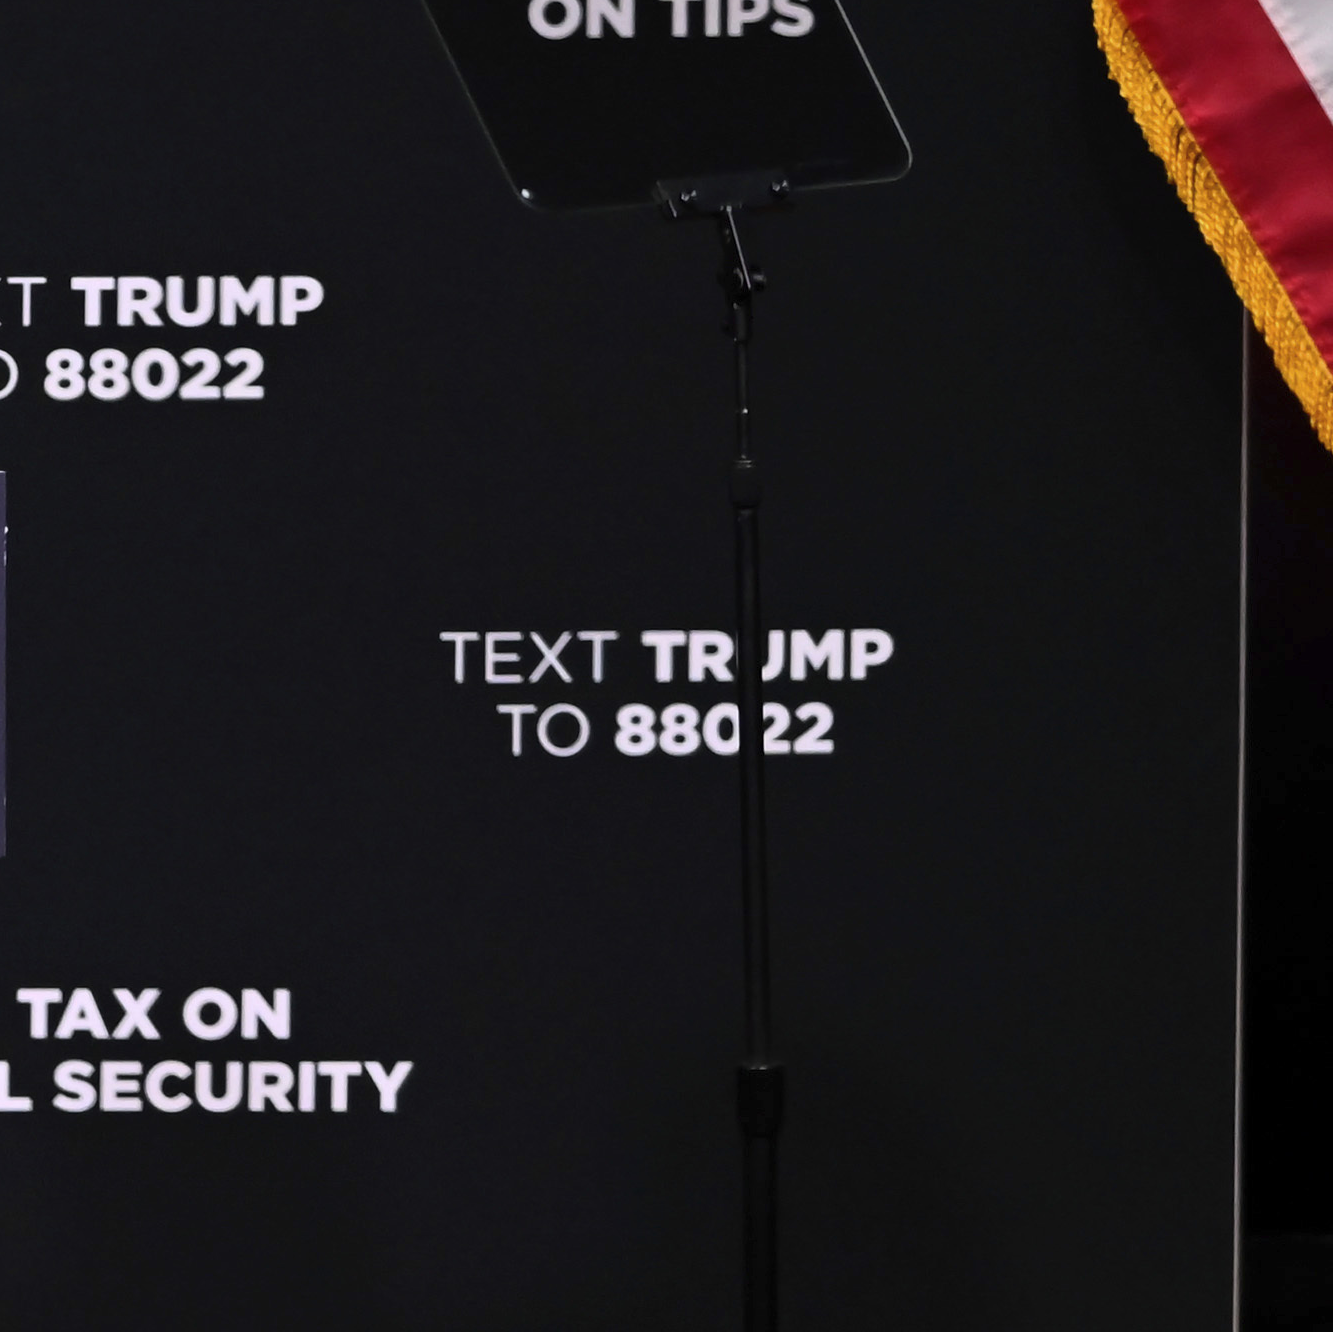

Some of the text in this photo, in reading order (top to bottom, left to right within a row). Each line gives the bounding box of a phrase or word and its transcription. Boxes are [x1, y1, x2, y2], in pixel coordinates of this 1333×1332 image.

[71, 276, 324, 327] TRUMP
[44, 348, 264, 400] 88022
[439, 630, 619, 684] TEXT
[496, 701, 835, 757] TO 88022
[17, 988, 160, 1040] TAX
[183, 988, 290, 1040] ON
[53, 1060, 412, 1112] SECURITY
